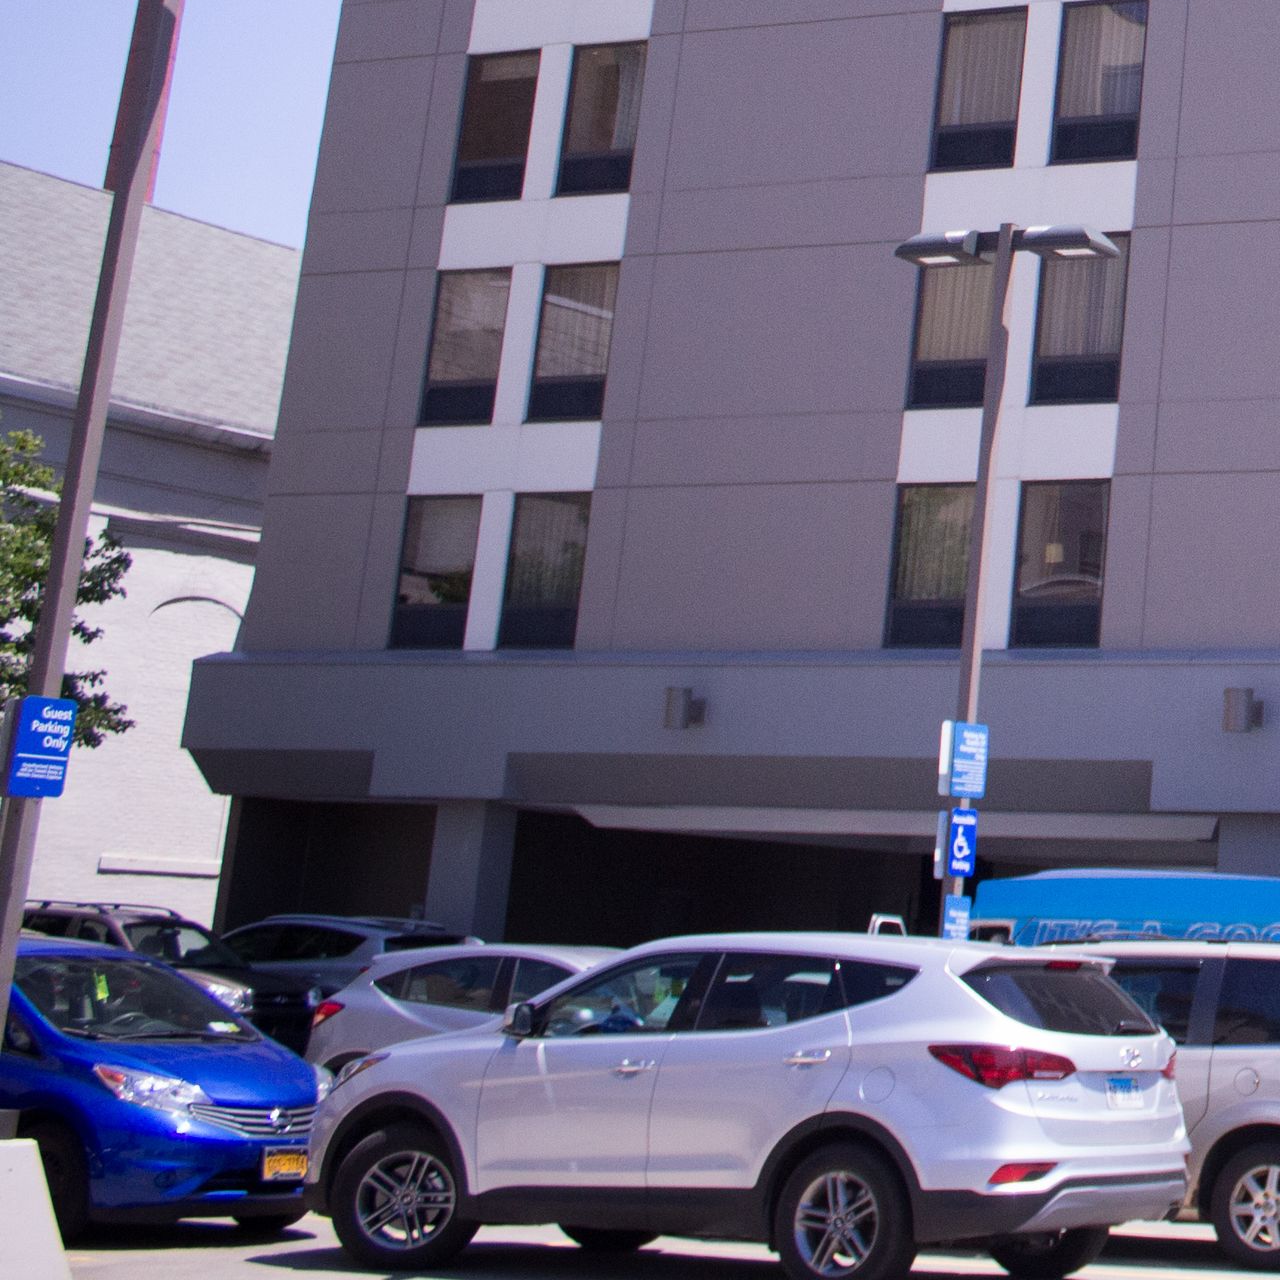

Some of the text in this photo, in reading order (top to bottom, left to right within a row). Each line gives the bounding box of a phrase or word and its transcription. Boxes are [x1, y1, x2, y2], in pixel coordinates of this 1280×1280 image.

[42, 705, 73, 720] Guest
[31, 719, 70, 737] Parking
[42, 735, 69, 752] Only
